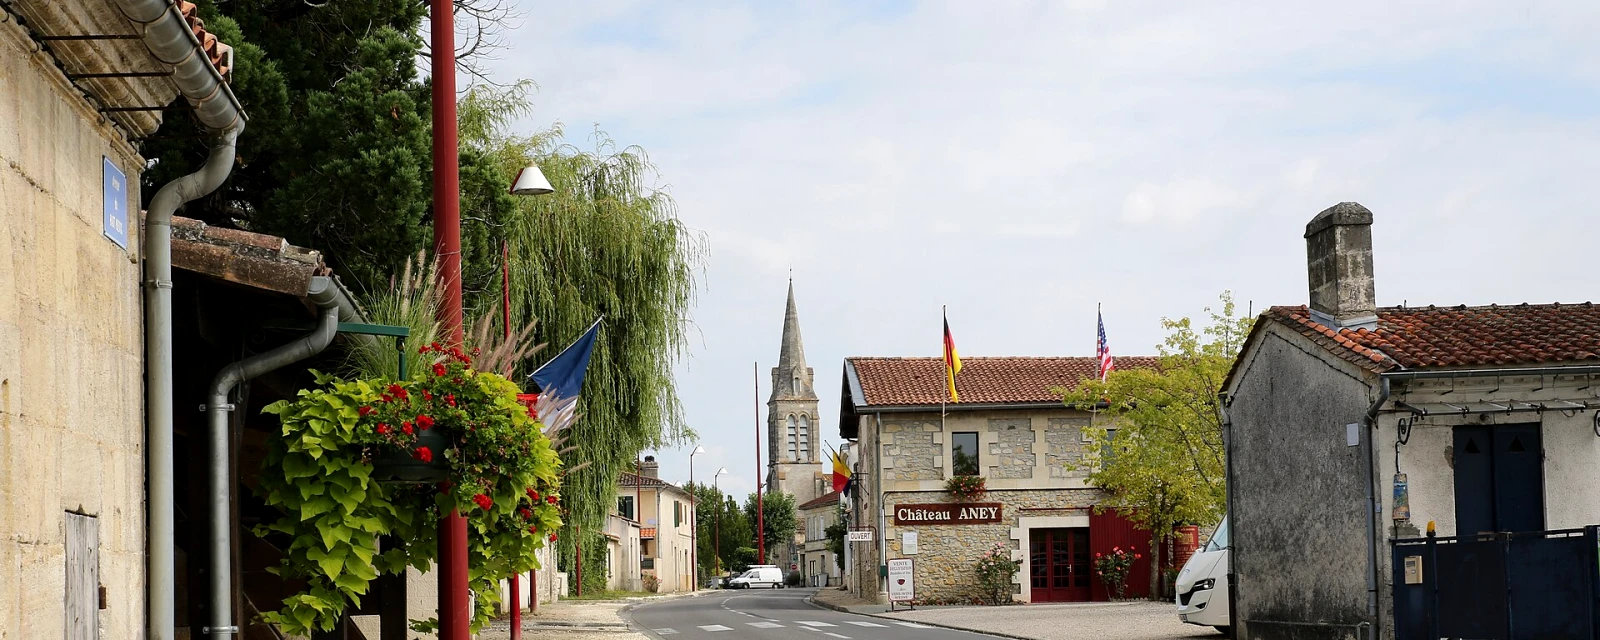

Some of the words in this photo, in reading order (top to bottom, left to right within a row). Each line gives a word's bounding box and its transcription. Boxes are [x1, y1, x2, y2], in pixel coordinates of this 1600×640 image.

[898, 508, 951, 521] Château
[958, 507, 998, 520] ANEY
[850, 532, 871, 540] OUVERT
